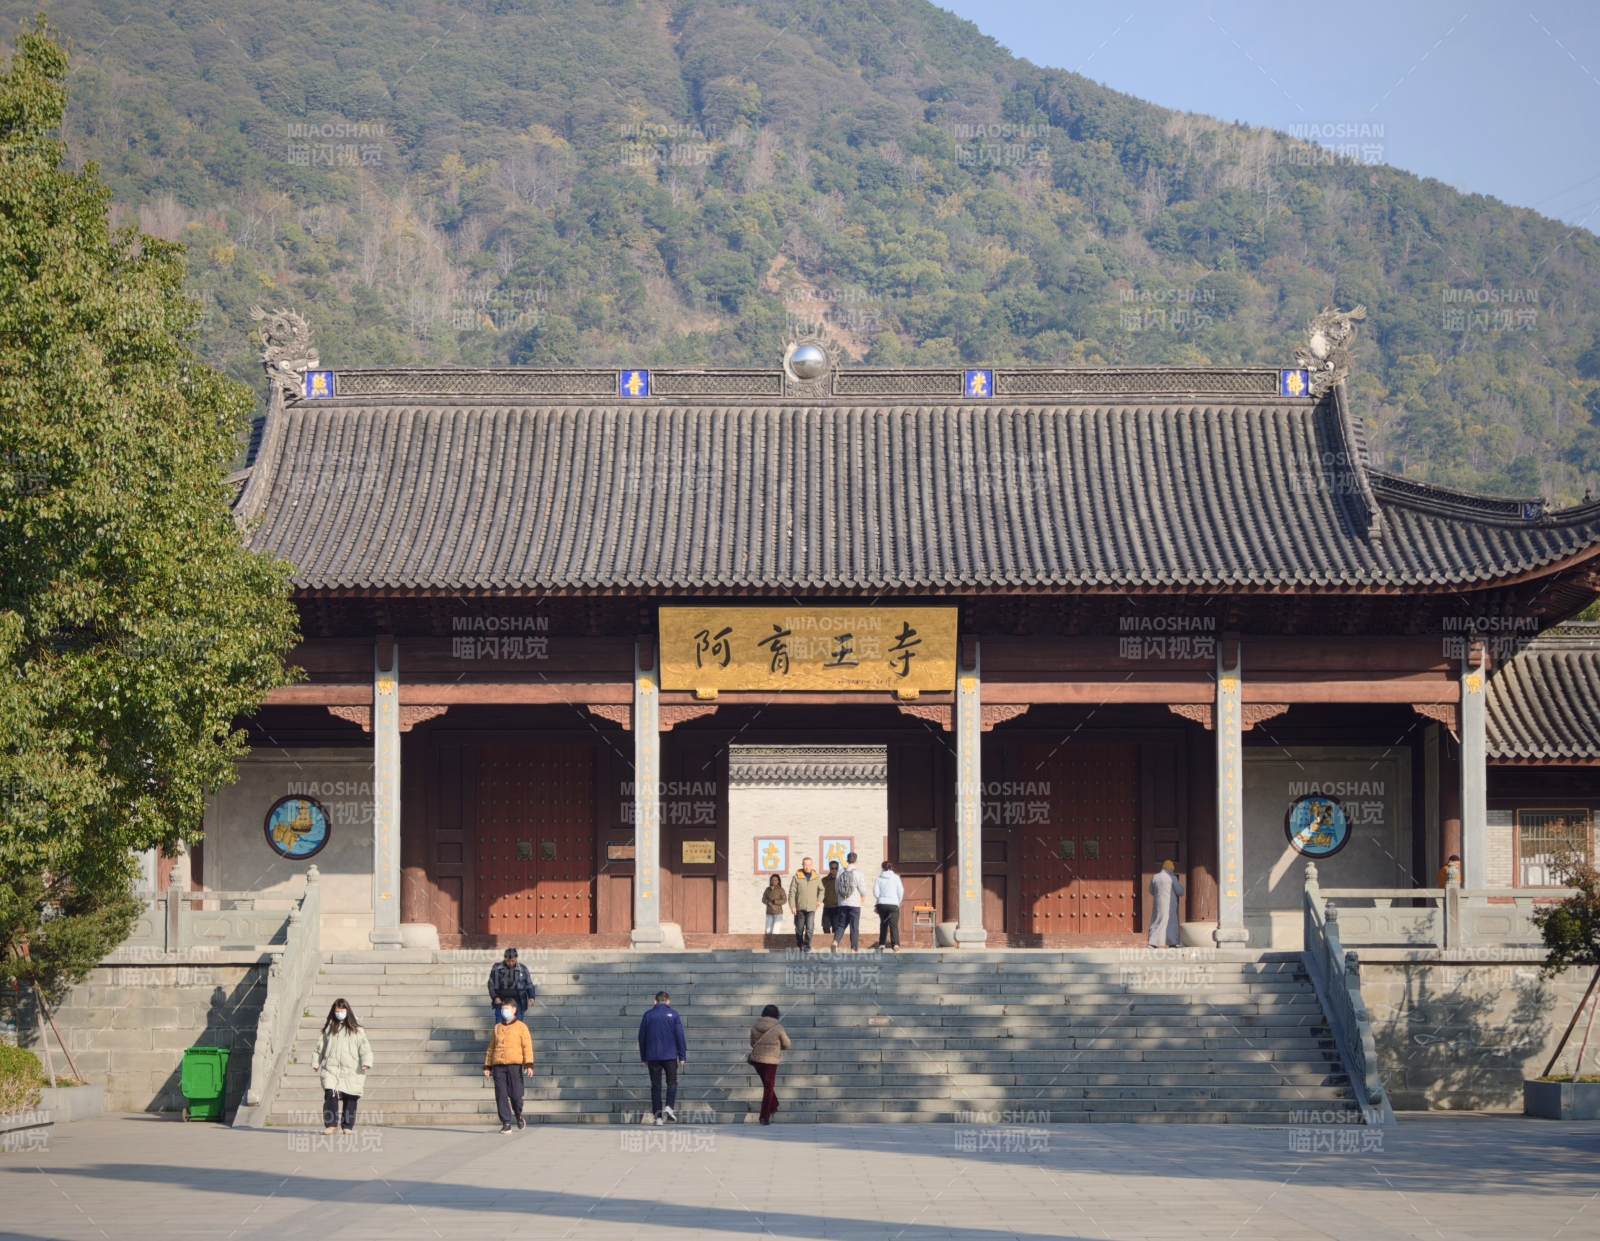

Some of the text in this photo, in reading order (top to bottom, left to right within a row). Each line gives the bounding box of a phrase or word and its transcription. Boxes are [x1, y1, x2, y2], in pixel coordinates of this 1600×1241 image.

[694, 621, 922, 678] 阿育王寺
[762, 840, 781, 870] 古
